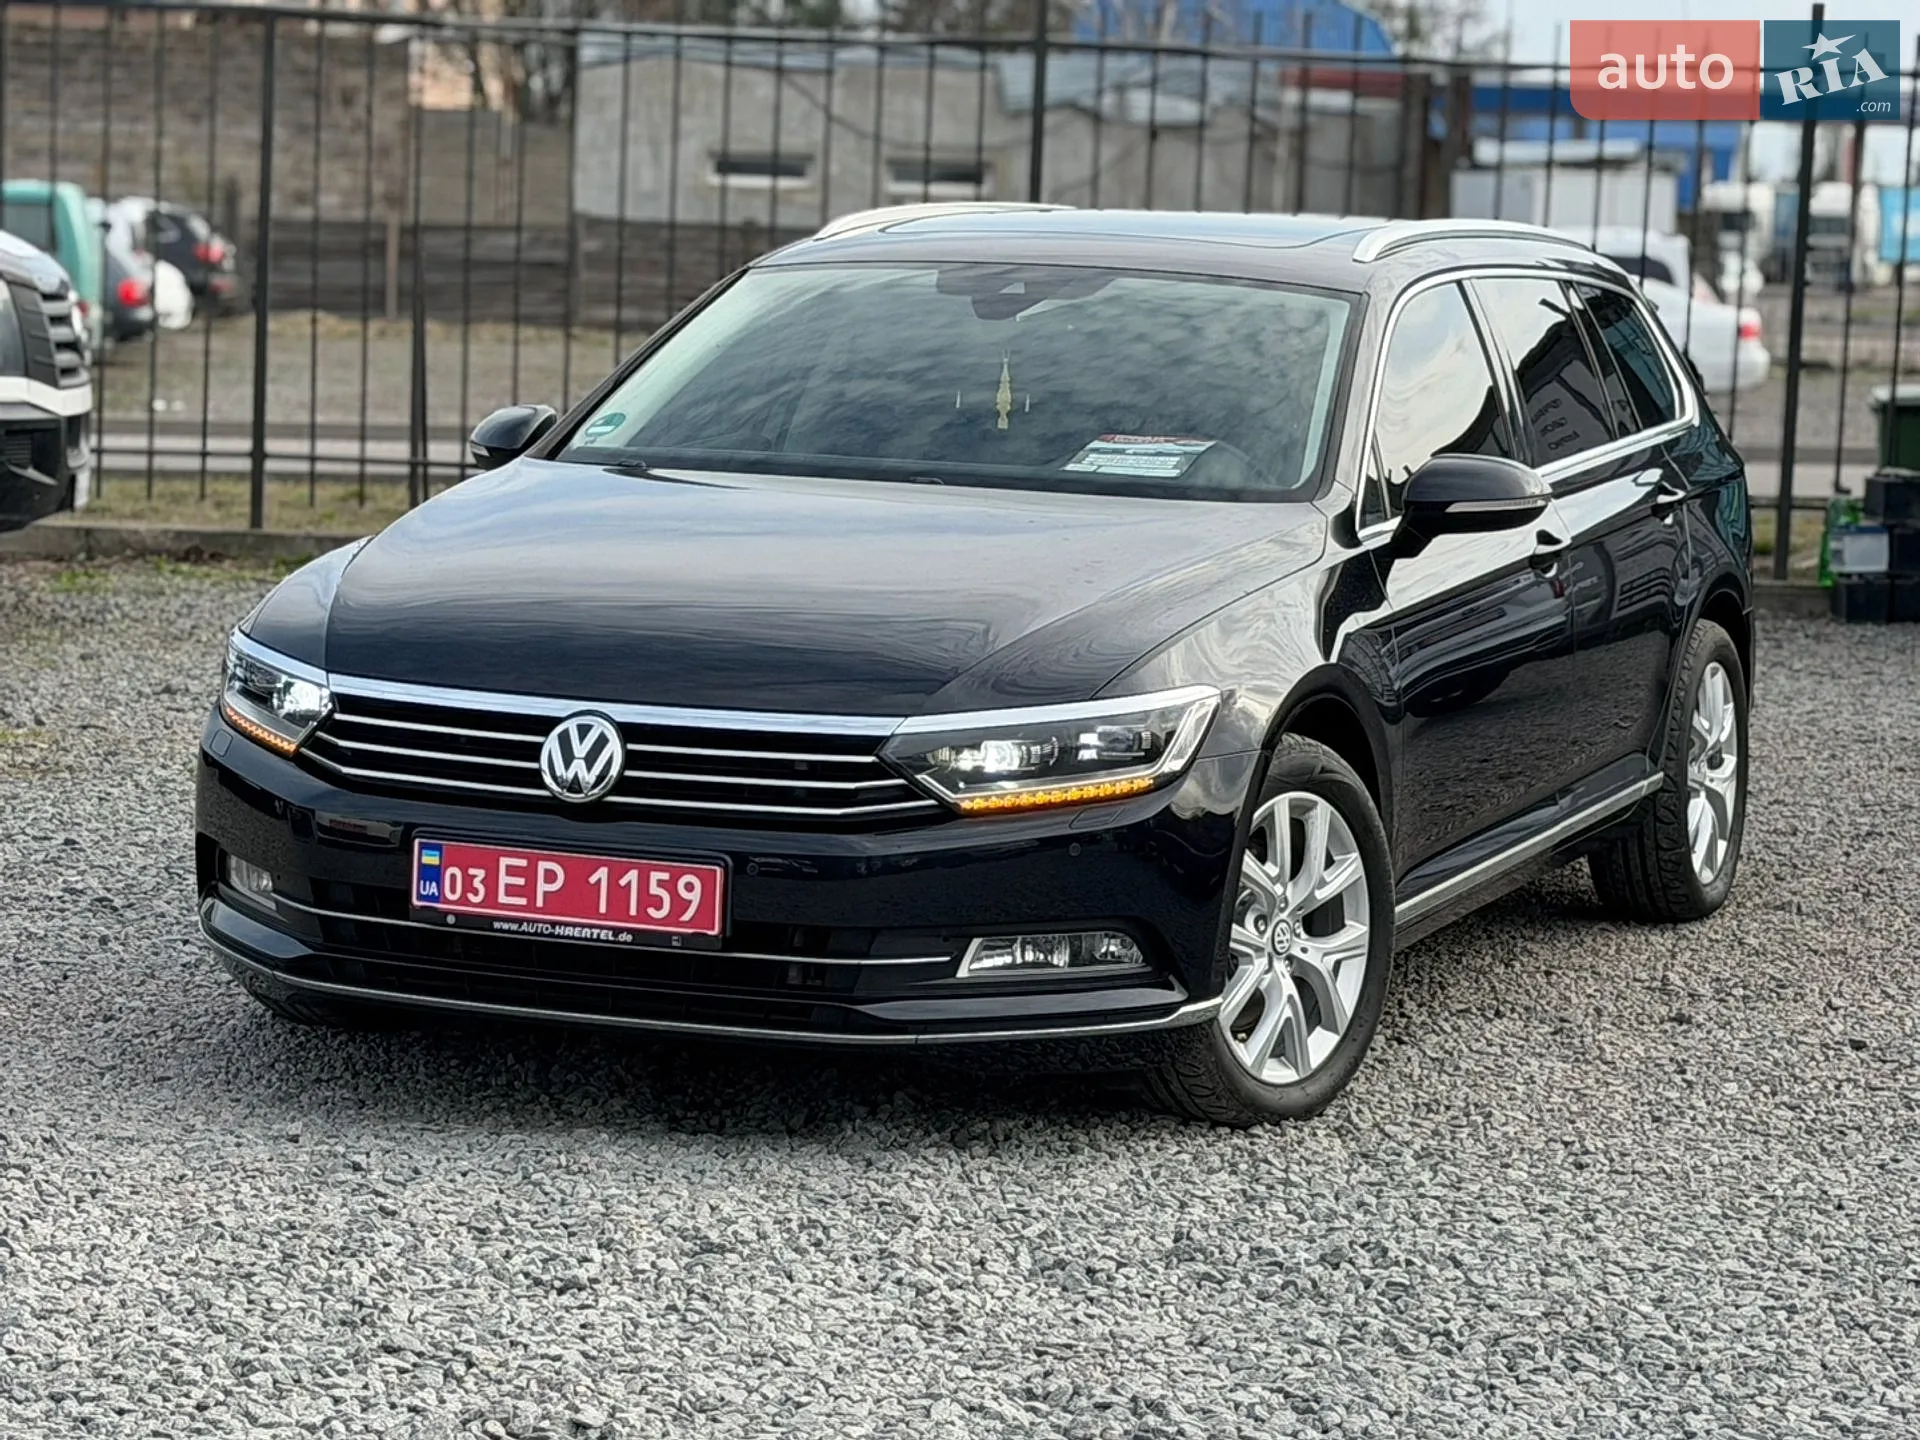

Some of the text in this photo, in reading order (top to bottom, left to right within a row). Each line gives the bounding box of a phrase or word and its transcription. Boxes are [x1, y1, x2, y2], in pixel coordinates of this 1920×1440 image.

[544, 720, 617, 798] VW
[420, 880, 439, 896] UA
[588, 867, 703, 921] 1159
